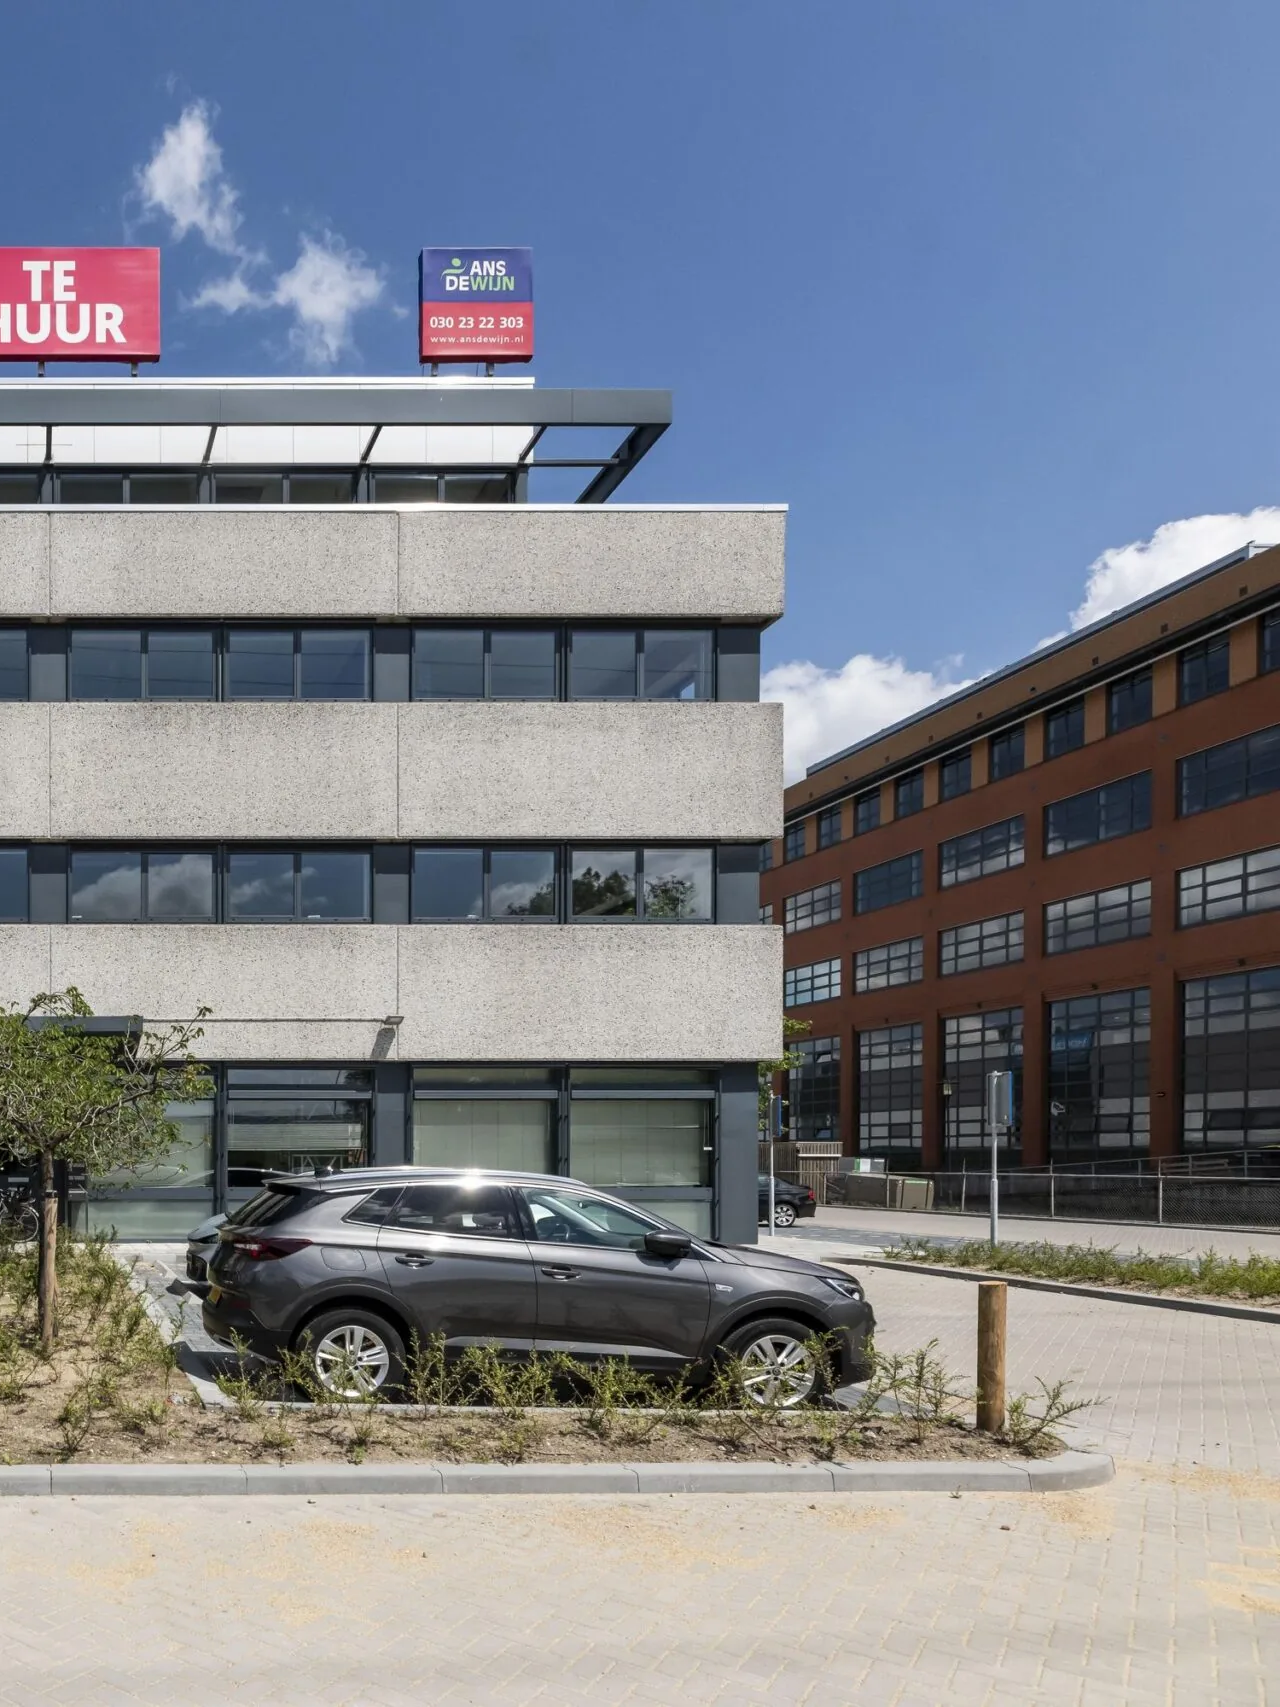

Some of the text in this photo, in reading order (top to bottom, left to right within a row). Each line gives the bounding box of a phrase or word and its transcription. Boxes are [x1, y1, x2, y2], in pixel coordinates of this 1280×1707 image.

[469, 260, 506, 276] ANS
[22, 260, 77, 301] TE
[445, 275, 515, 291] DEWIJN
[429, 316, 524, 329] 030 23 22 303
[430, 335, 524, 345] www.ansdewijn.nl
